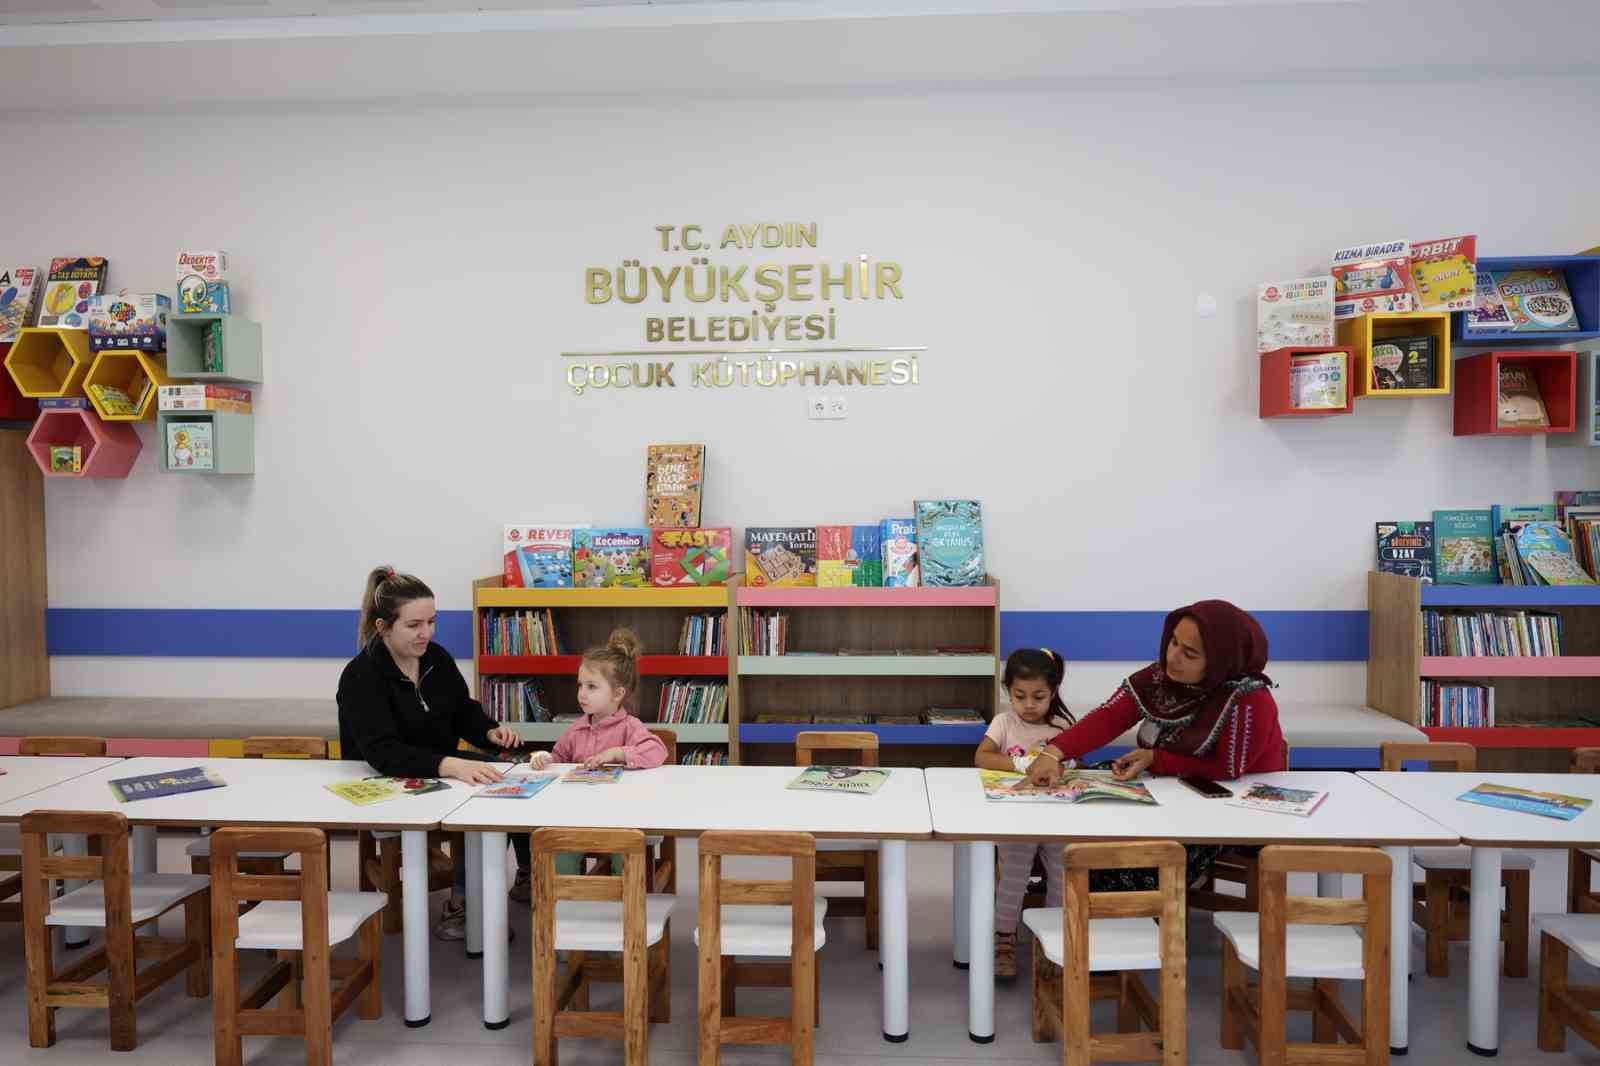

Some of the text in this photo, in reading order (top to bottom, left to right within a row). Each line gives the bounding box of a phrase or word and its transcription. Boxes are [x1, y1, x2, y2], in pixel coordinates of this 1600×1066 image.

[656, 222, 818, 252] T.C. AYDIN
[583, 253, 905, 313] BÜYÜKŞEHİR
[646, 307, 837, 343] BELEDİYESİ
[565, 352, 921, 396] ÇOCUK KÜTÜPHANESİ
[656, 531, 717, 549] FAST
